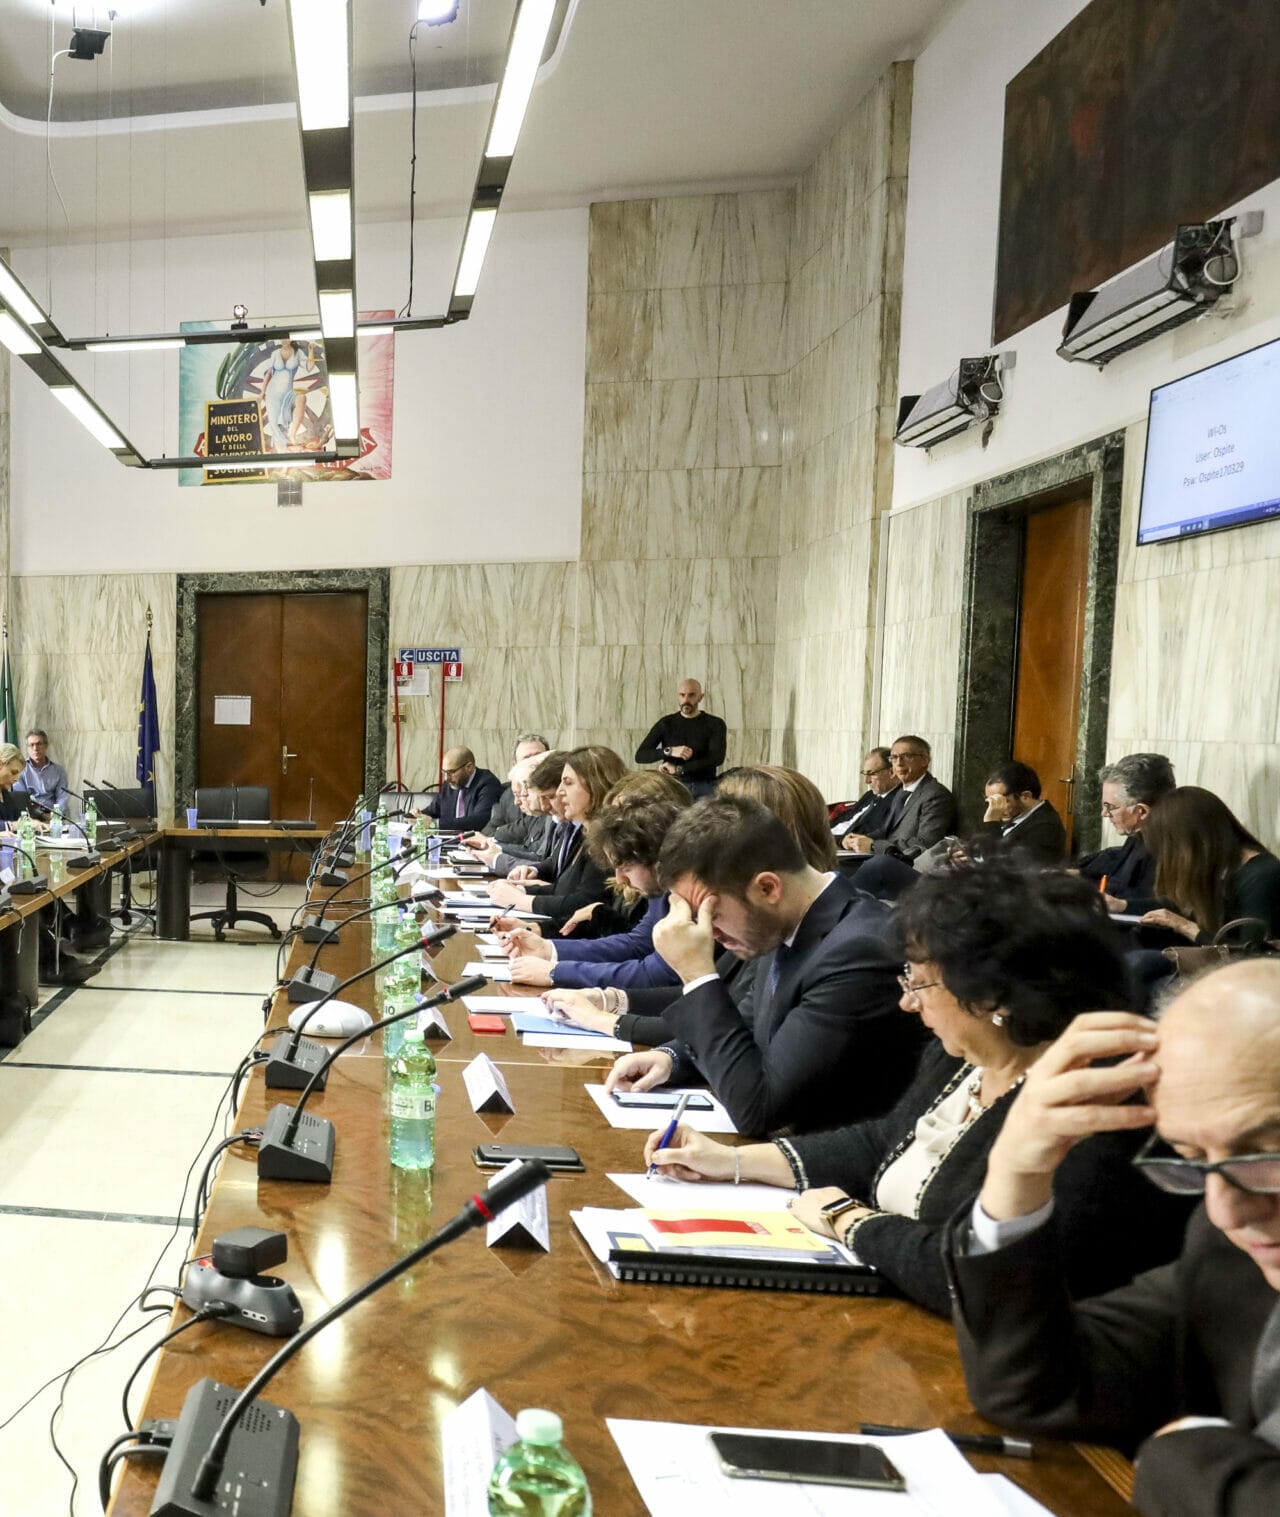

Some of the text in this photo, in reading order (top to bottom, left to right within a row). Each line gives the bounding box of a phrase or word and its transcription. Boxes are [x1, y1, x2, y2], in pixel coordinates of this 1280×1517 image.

[210, 413, 258, 426] MINISTERO
[215, 433, 253, 444] LAVORO
[418, 650, 458, 662] USCITA
